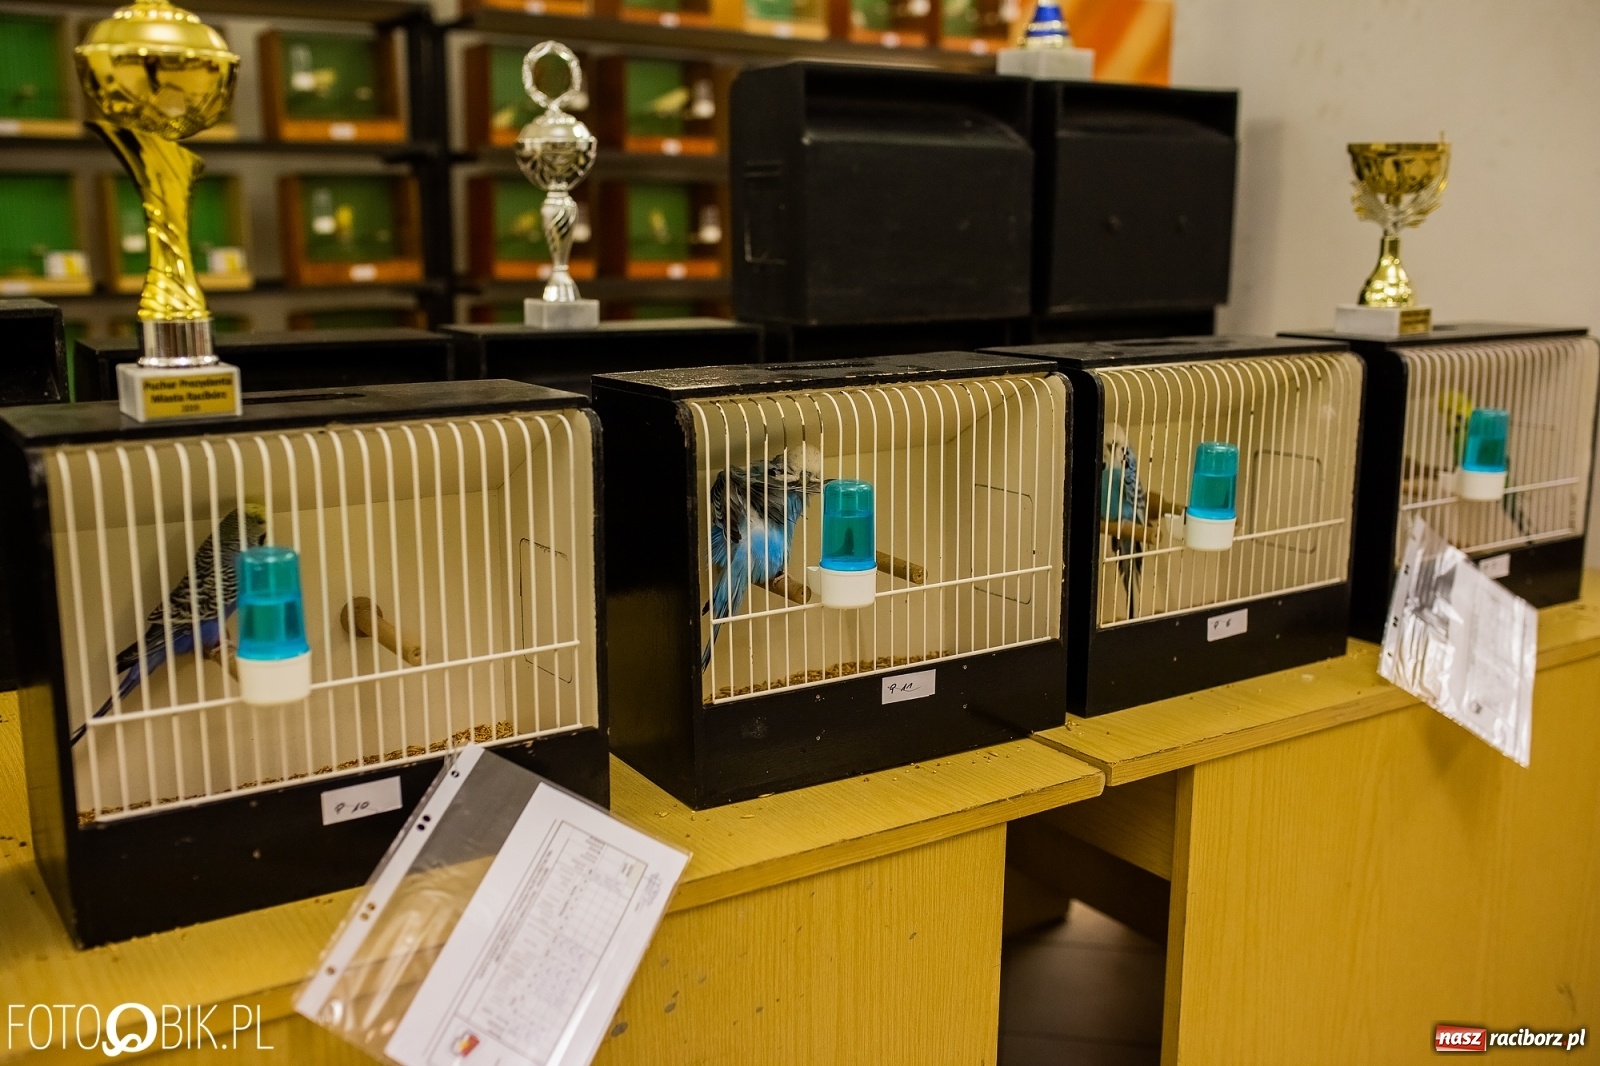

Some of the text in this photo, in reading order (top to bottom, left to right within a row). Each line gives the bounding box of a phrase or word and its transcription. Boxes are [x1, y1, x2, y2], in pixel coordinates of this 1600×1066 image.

[143, 378, 232, 391] Puchar Prezydenta
[151, 394, 184, 403] Miasta
